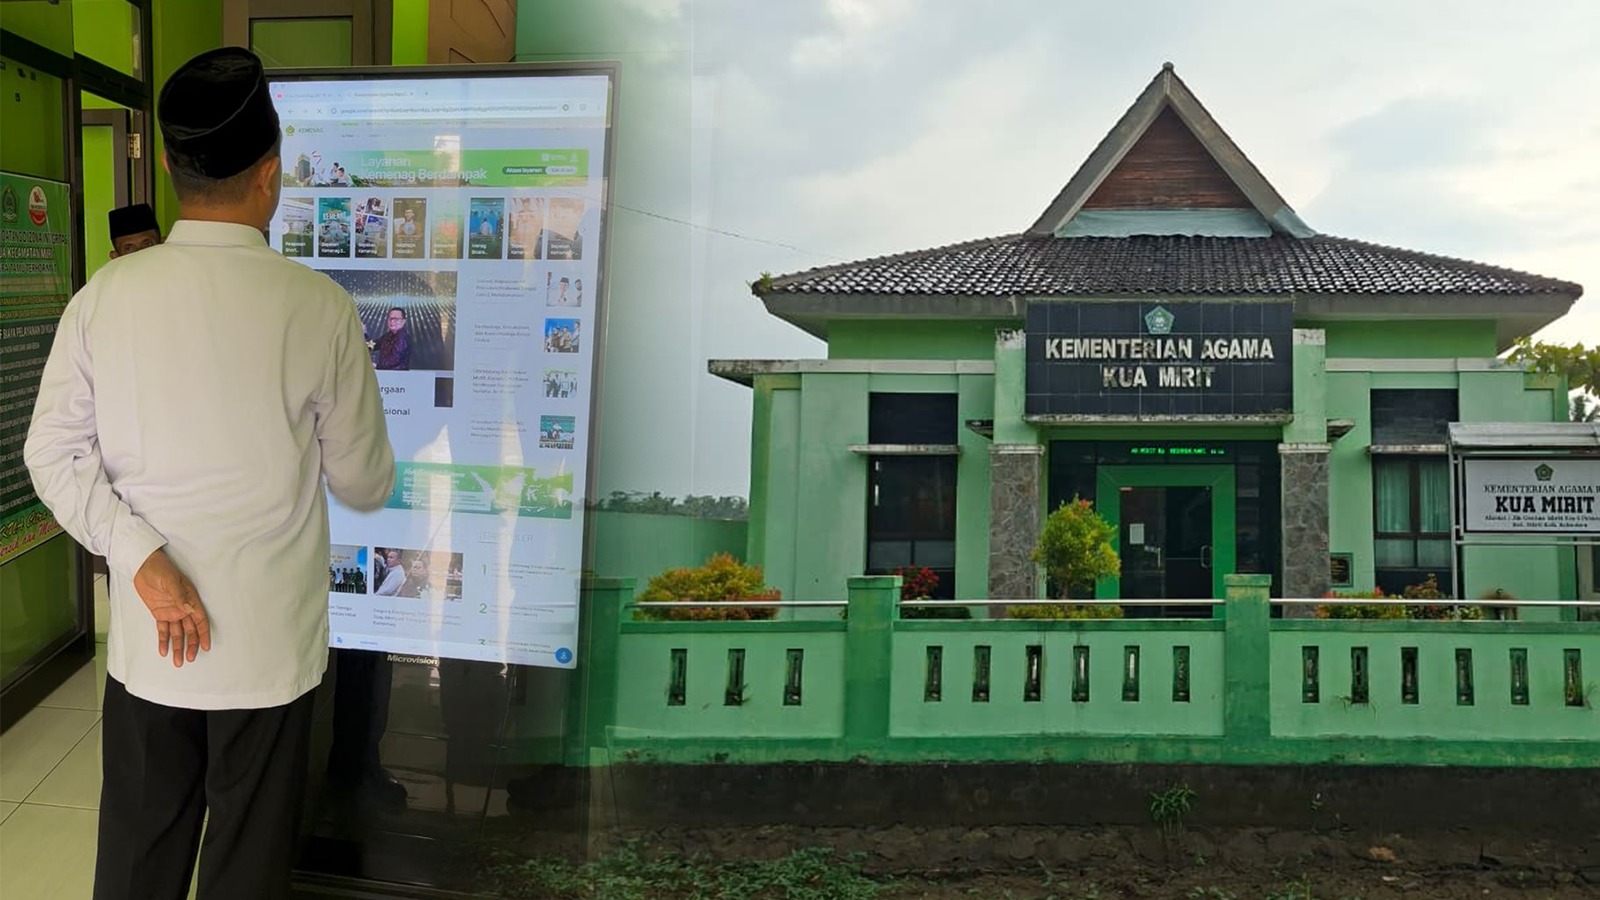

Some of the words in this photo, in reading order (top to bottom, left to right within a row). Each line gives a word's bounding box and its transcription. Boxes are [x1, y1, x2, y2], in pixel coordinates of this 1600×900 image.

[361, 157, 411, 169] Layanan
[361, 169, 415, 183] Kemenag
[418, 168, 487, 182] Berdampak
[7, 247, 40, 259] KECAMATAN
[1045, 338, 1193, 359] KEMENTERIAN
[1200, 338, 1274, 359] AGAMA
[1103, 366, 1148, 388] KUA
[1158, 365, 1216, 388] MIRIT
[1484, 485, 1556, 494] KEMENTERIAN
[1558, 485, 1593, 494] AGAMA
[1495, 496, 1536, 513] KUA
[1541, 496, 1595, 513] MIRIT
[479, 602, 488, 614] 2
[387, 654, 439, 667] Microvision
